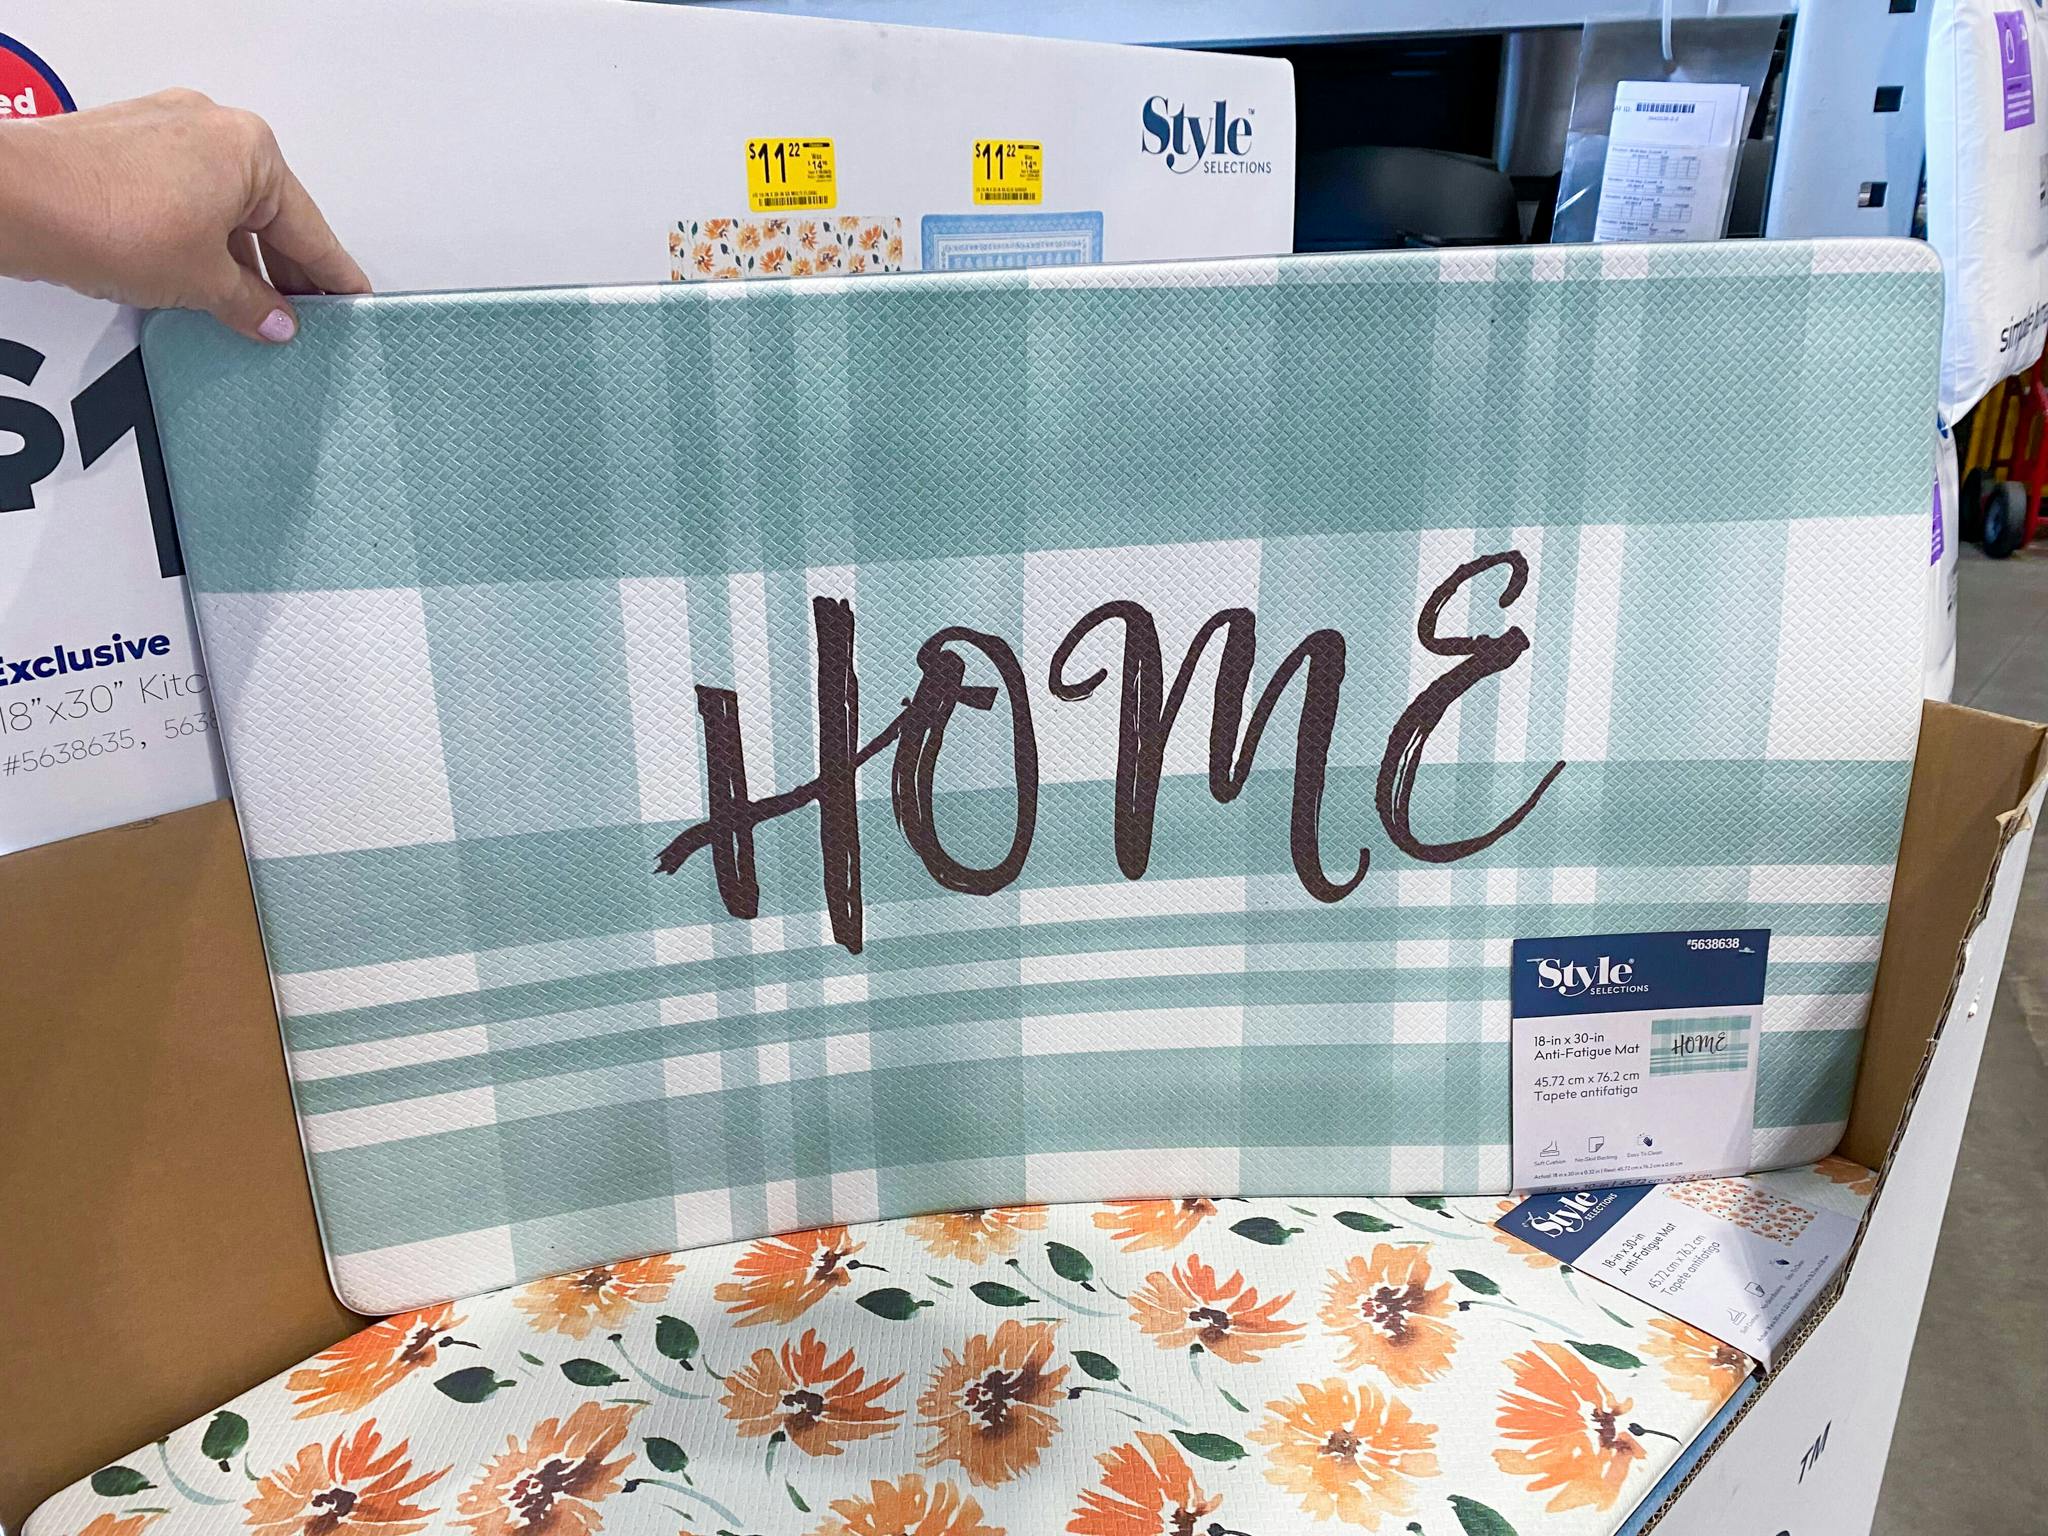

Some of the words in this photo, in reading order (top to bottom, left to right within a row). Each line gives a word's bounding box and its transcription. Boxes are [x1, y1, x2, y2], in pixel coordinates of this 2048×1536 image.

[1142, 95, 1253, 174] Style
[1203, 161, 1272, 174] SELECTIONS
[3, 728, 147, 777] #5638635,
[653, 549, 1566, 956] HOME
[1686, 938, 1740, 951] #5638638
[1538, 955, 1633, 997] Style
[1590, 984, 1649, 996] SELECTIONS
[1534, 1035, 1562, 1047] 18-in
[1564, 1037, 1571, 1045] x
[1573, 1032, 1605, 1044] 30-in
[1534, 1047, 1612, 1061] Anti-Fatigue
[1614, 1043, 1640, 1055] Mat
[1671, 1031, 1729, 1057] HOME
[1533, 1089, 1578, 1104] Tapete
[1580, 1085, 1638, 1098] antifatiga
[1534, 1075, 1565, 1087] 45.72
[1567, 1076, 1585, 1085] cm
[1597, 1071, 1620, 1083] 76.2
[1622, 1072, 1640, 1081] cm
[1531, 1192, 1598, 1238] Style
[1584, 1192, 1618, 1220] SELECTIONS
[1602, 1252, 1626, 1268] 18-in
[1622, 1233, 1646, 1250] 30-in
[1619, 1235, 1664, 1276] Anti-Fatigue
[1659, 1222, 1677, 1238] Mat
[1648, 1270, 1671, 1290] 45.72
[1666, 1261, 1681, 1273] cm
[1676, 1243, 1699, 1258] 76.2
[1693, 1234, 1707, 1245] cm
[1660, 1272, 1691, 1296] Tapete
[1688, 1241, 1720, 1273] antifatiga
[1798, 1419, 1832, 1485] TM
